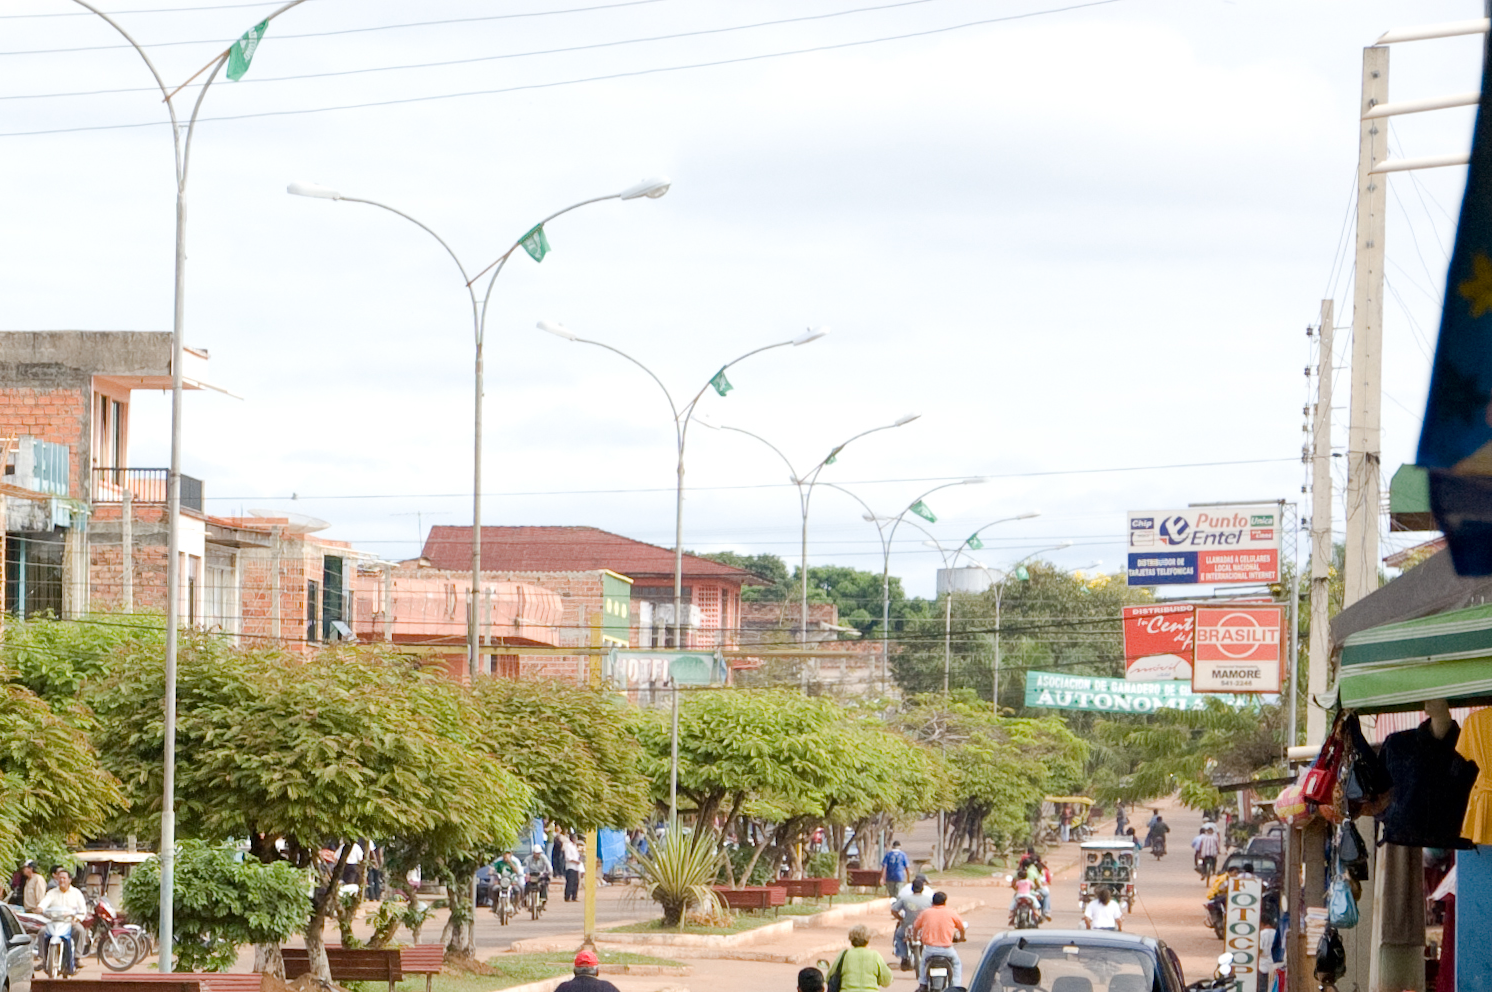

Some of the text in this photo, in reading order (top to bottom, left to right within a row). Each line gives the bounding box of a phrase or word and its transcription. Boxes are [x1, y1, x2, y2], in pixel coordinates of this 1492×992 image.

[1195, 512, 1248, 528] Punto
[1190, 530, 1243, 545] Entel
[1197, 628, 1279, 642] BRASILIT
[1036, 675, 1091, 690] ASOCIACION
[1094, 680, 1108, 691] DE
[1164, 684, 1178, 696] DE
[1036, 688, 1208, 712] AUTONOMIA
